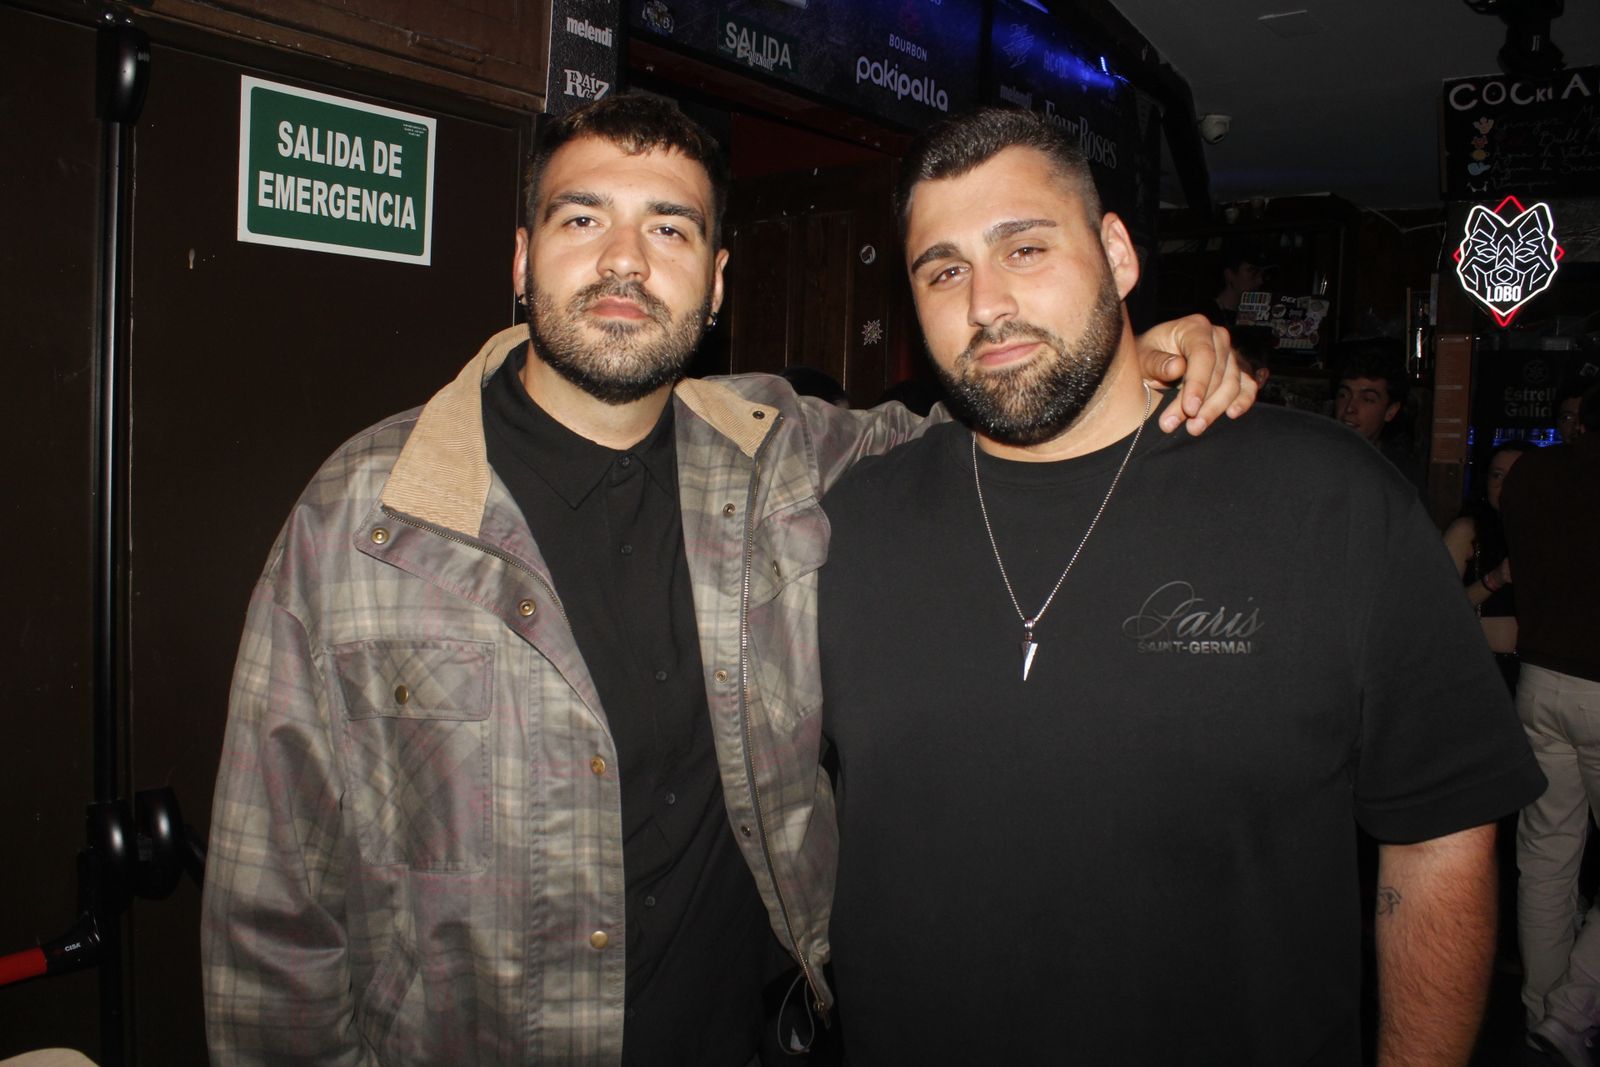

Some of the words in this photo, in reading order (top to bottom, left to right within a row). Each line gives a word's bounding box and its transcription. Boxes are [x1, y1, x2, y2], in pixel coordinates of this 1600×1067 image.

[567, 17, 613, 48] melendi
[725, 21, 792, 70] SALIDA
[888, 32, 928, 63] BOURBON
[856, 55, 949, 112] pakipalla
[1044, 99, 1079, 135] Four
[277, 120, 366, 171] SALIDA
[372, 140, 403, 178] DE
[258, 170, 417, 230] EMERGENCIA
[1486, 285, 1522, 302] LOBO
[1504, 386, 1557, 401] Estrell
[1504, 402, 1552, 418] Galici
[1121, 580, 1265, 640] Paris
[1137, 641, 1252, 655] SAINT-GERMAI
